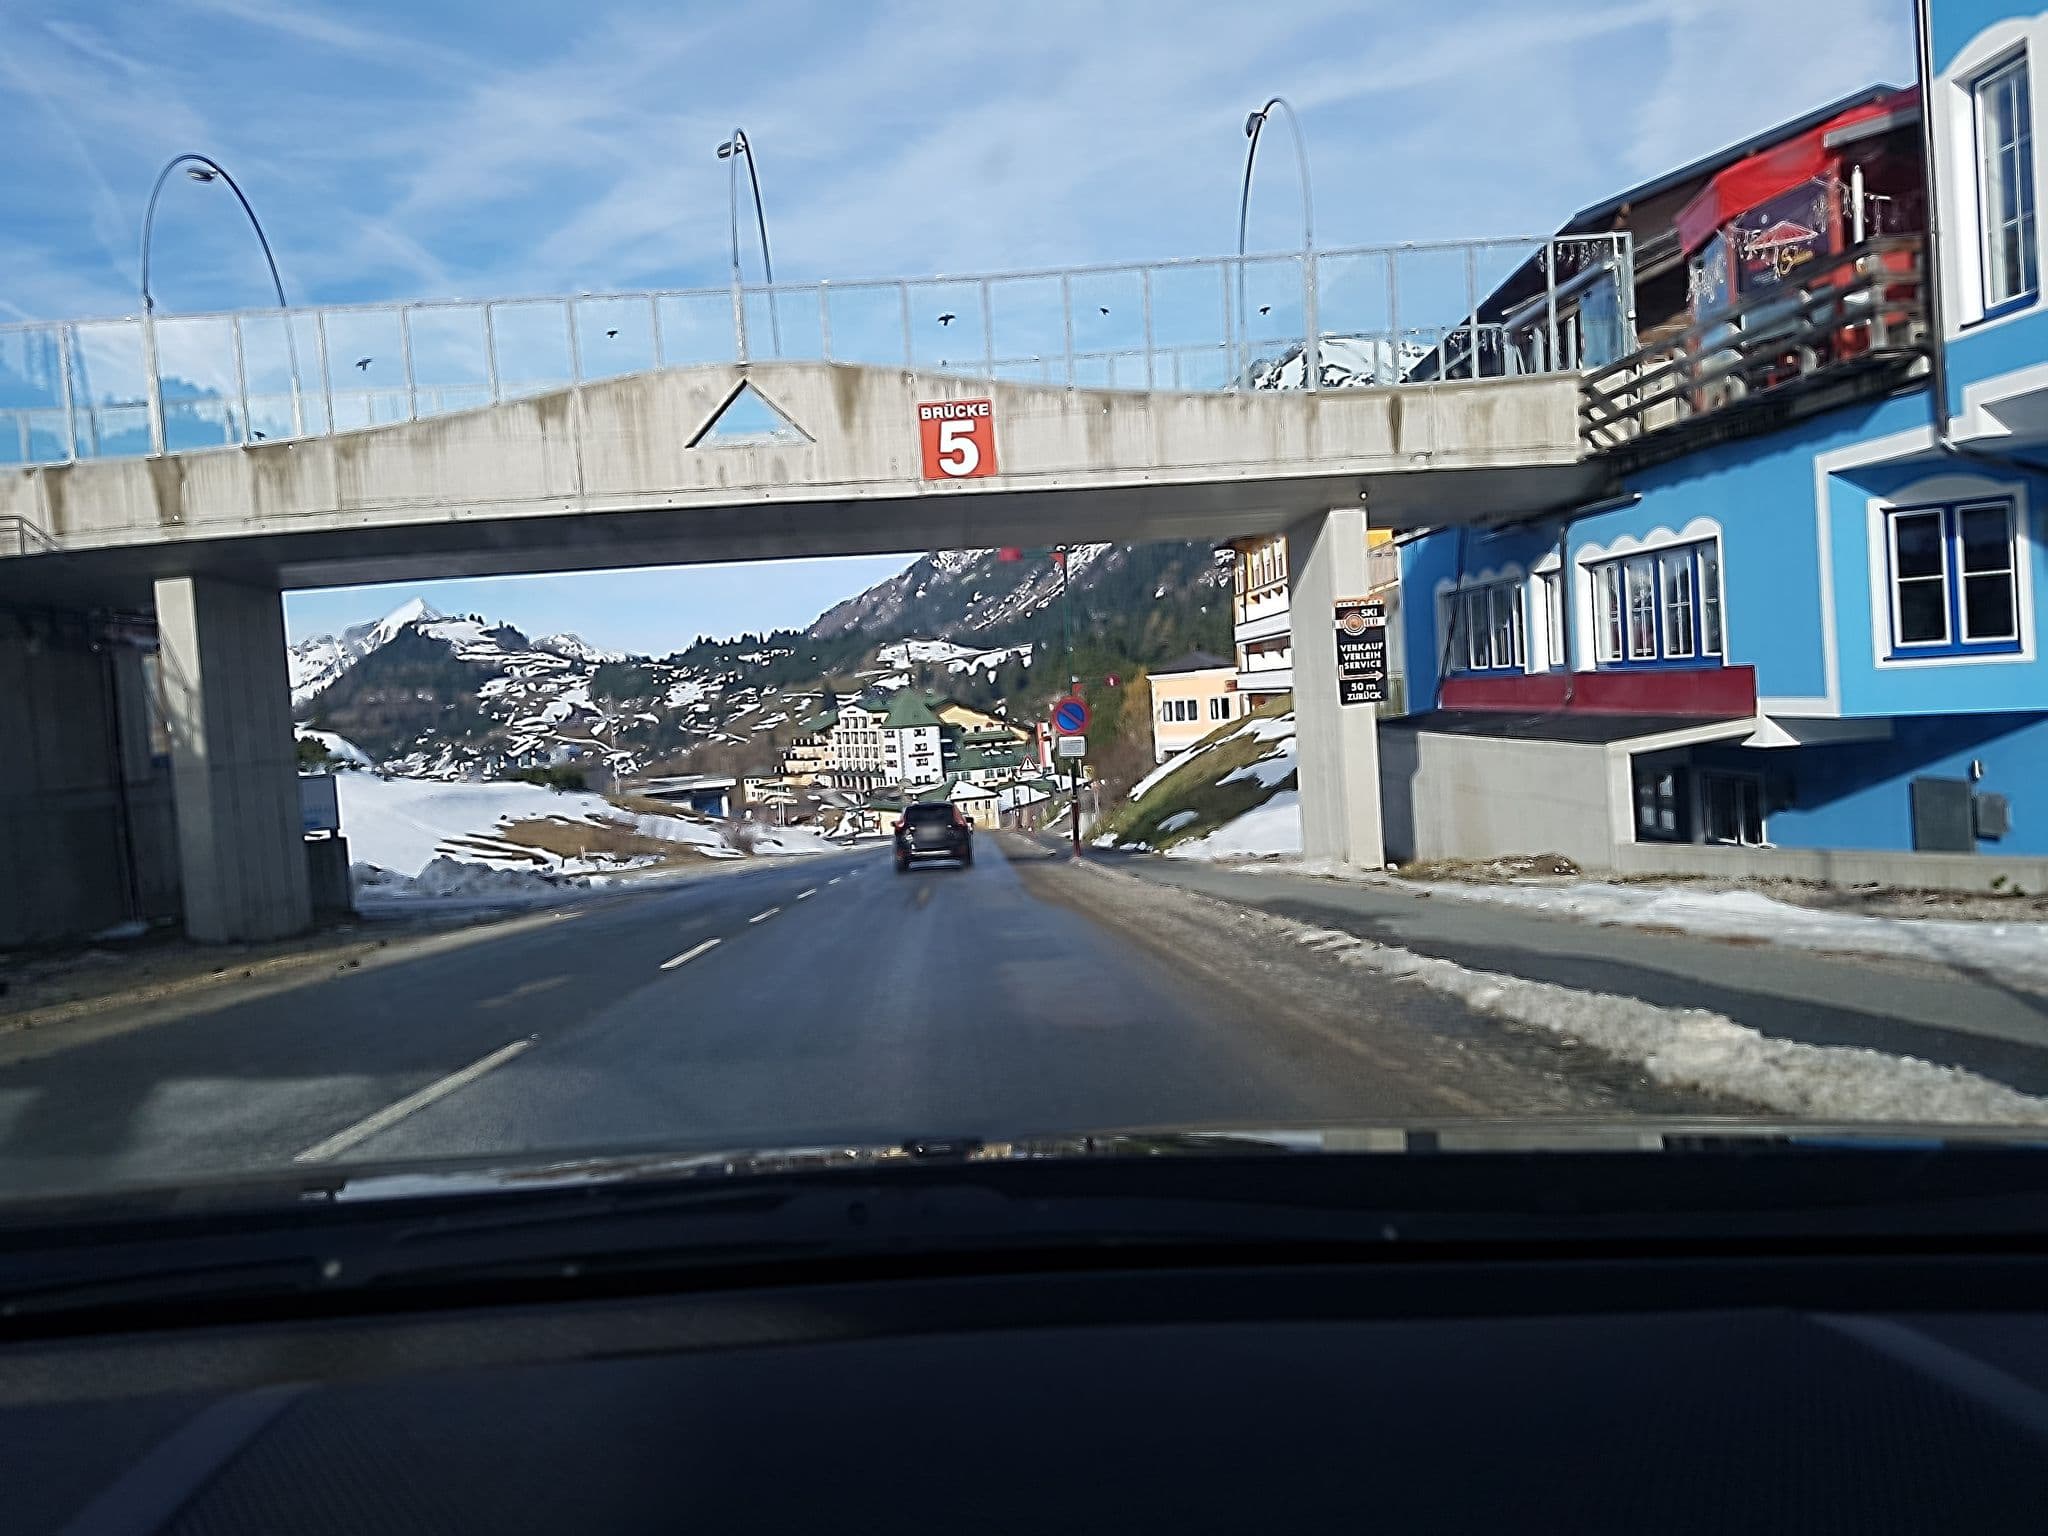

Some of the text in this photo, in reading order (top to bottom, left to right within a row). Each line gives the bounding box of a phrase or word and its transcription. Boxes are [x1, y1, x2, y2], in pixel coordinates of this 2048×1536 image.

[920, 403, 989, 419] BRÜCKE
[939, 419, 979, 476] 5
[1360, 608, 1378, 617] SKI
[1340, 642, 1383, 652] VERKAUF
[1343, 651, 1381, 660] VERLEIH
[1344, 660, 1381, 669] SERVICE
[1351, 682, 1376, 691] 50 m
[1346, 691, 1382, 700] ZURÜCK
